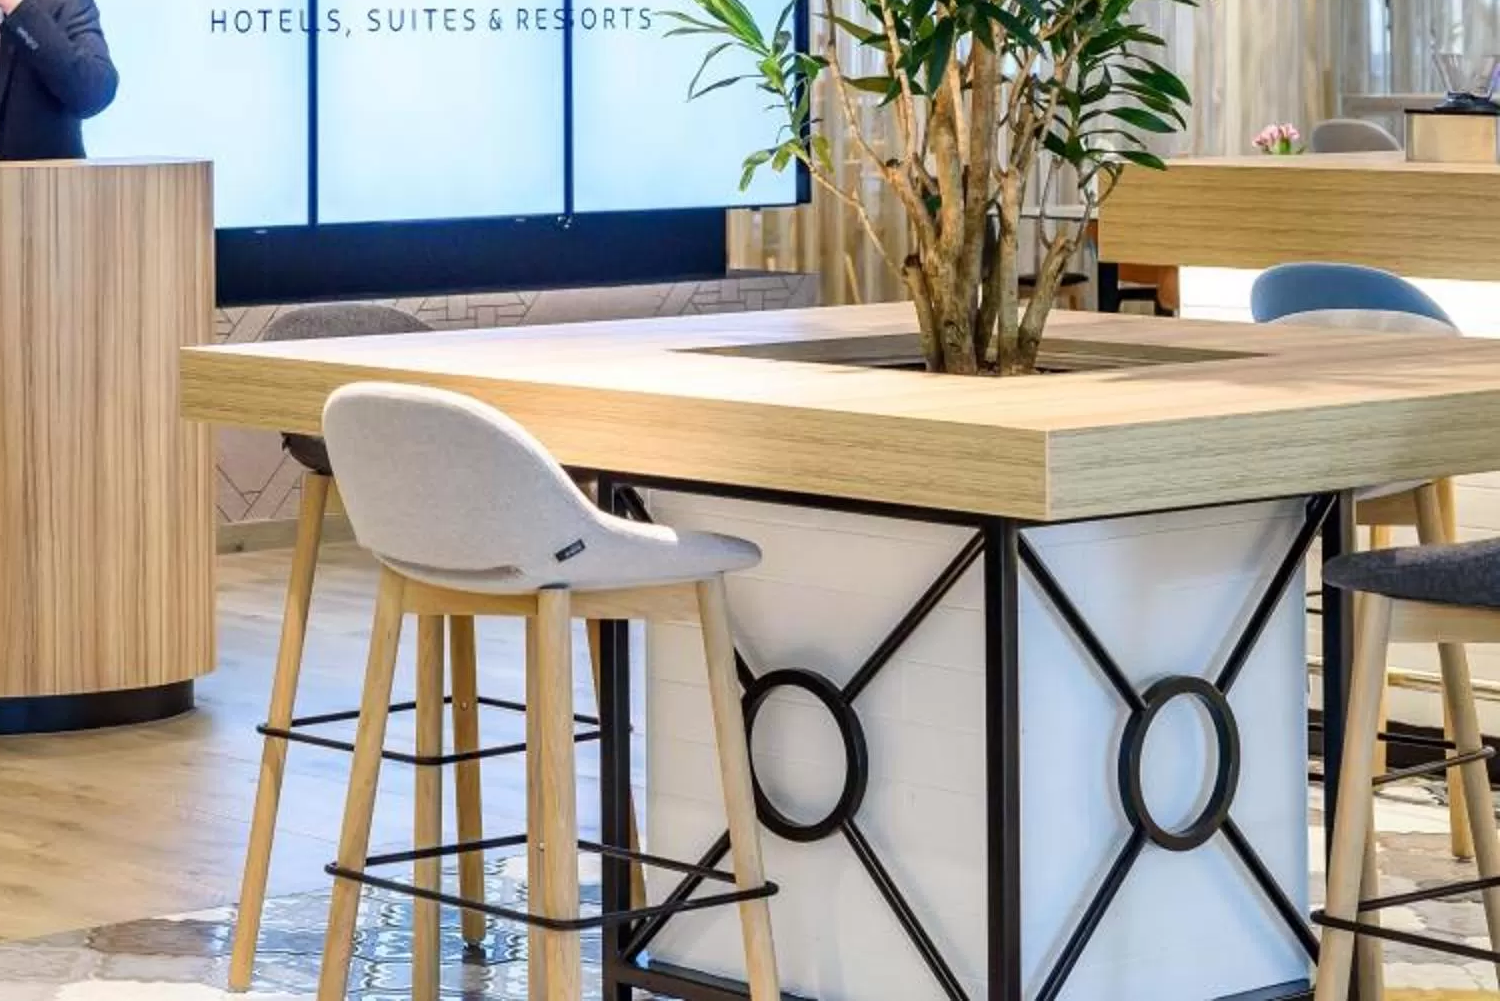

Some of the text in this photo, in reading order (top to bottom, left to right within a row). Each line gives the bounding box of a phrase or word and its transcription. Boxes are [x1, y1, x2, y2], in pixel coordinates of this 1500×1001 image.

[211, 6, 652, 38] HOTELS, SUITES & RESORTS
